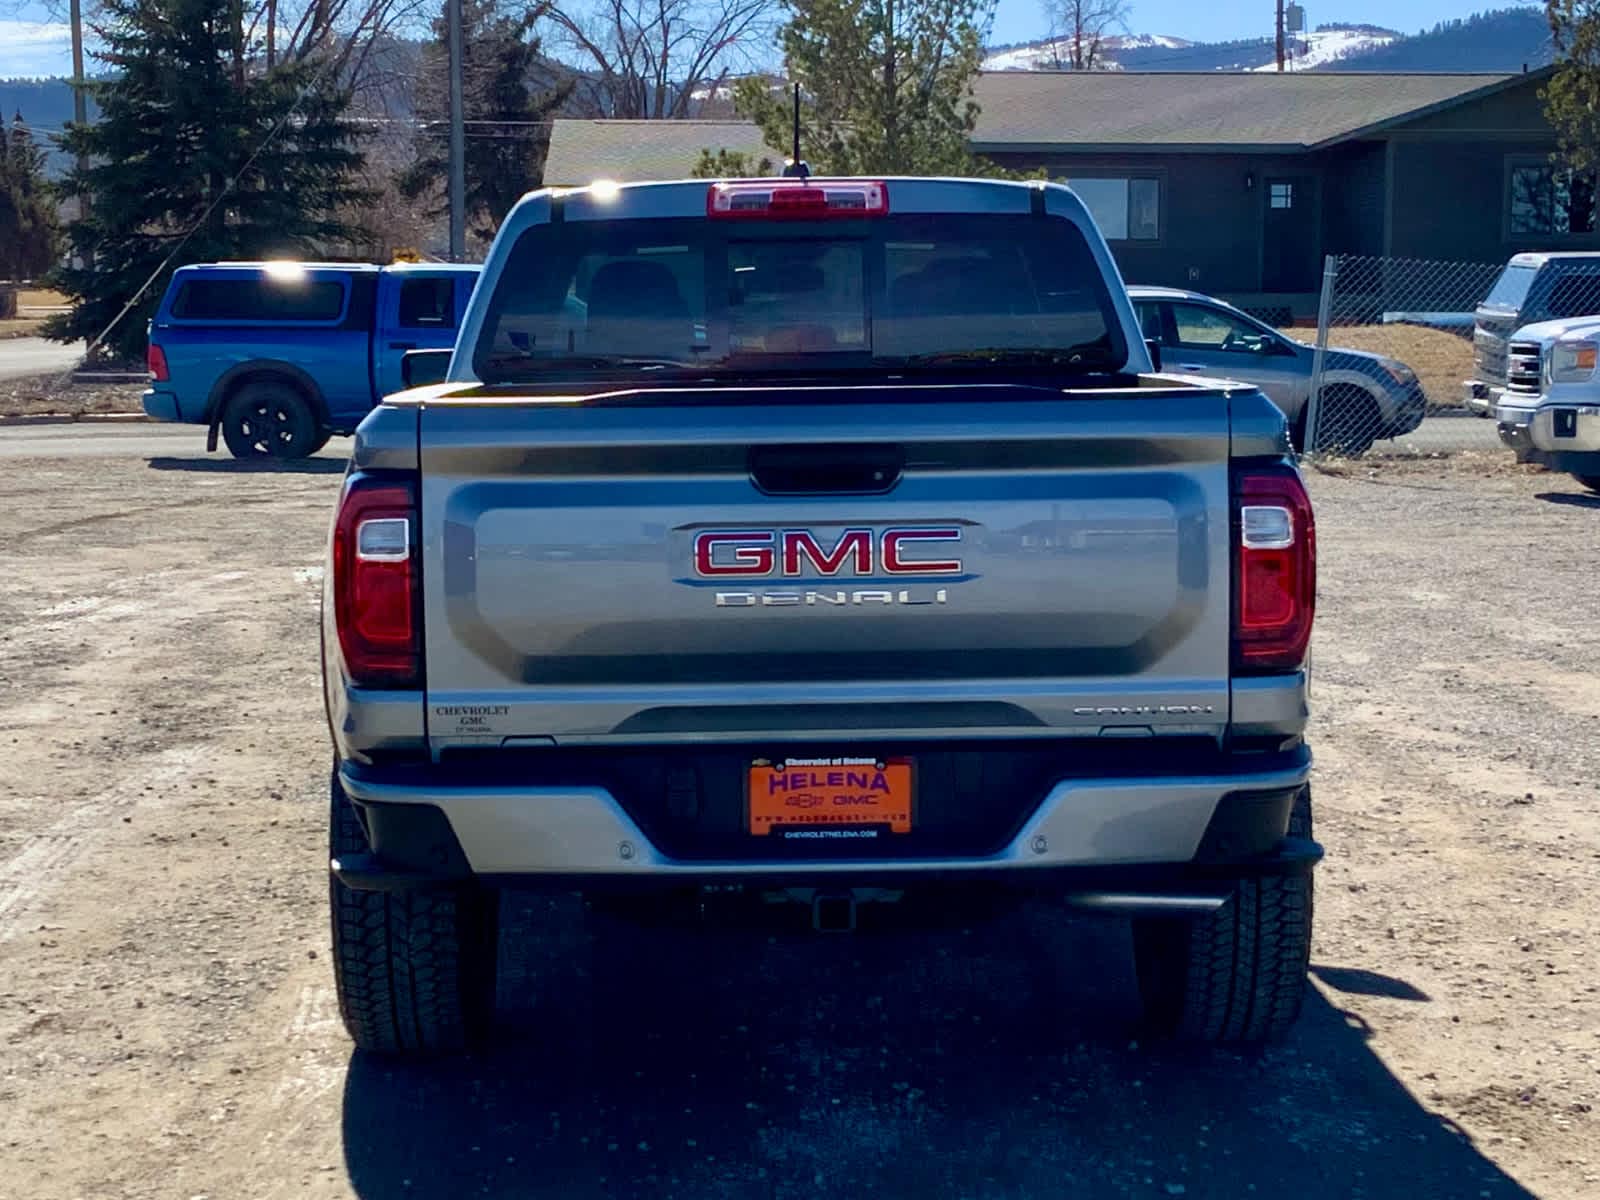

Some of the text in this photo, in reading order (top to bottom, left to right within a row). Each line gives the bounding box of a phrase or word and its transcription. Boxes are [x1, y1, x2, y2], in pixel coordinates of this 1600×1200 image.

[695, 528, 961, 577] GMC
[716, 590, 948, 607] DENALI
[436, 705, 510, 716] CHEVROLET
[460, 716, 486, 725] GMC
[769, 772, 891, 796] HELENA
[832, 795, 879, 806] GMC
